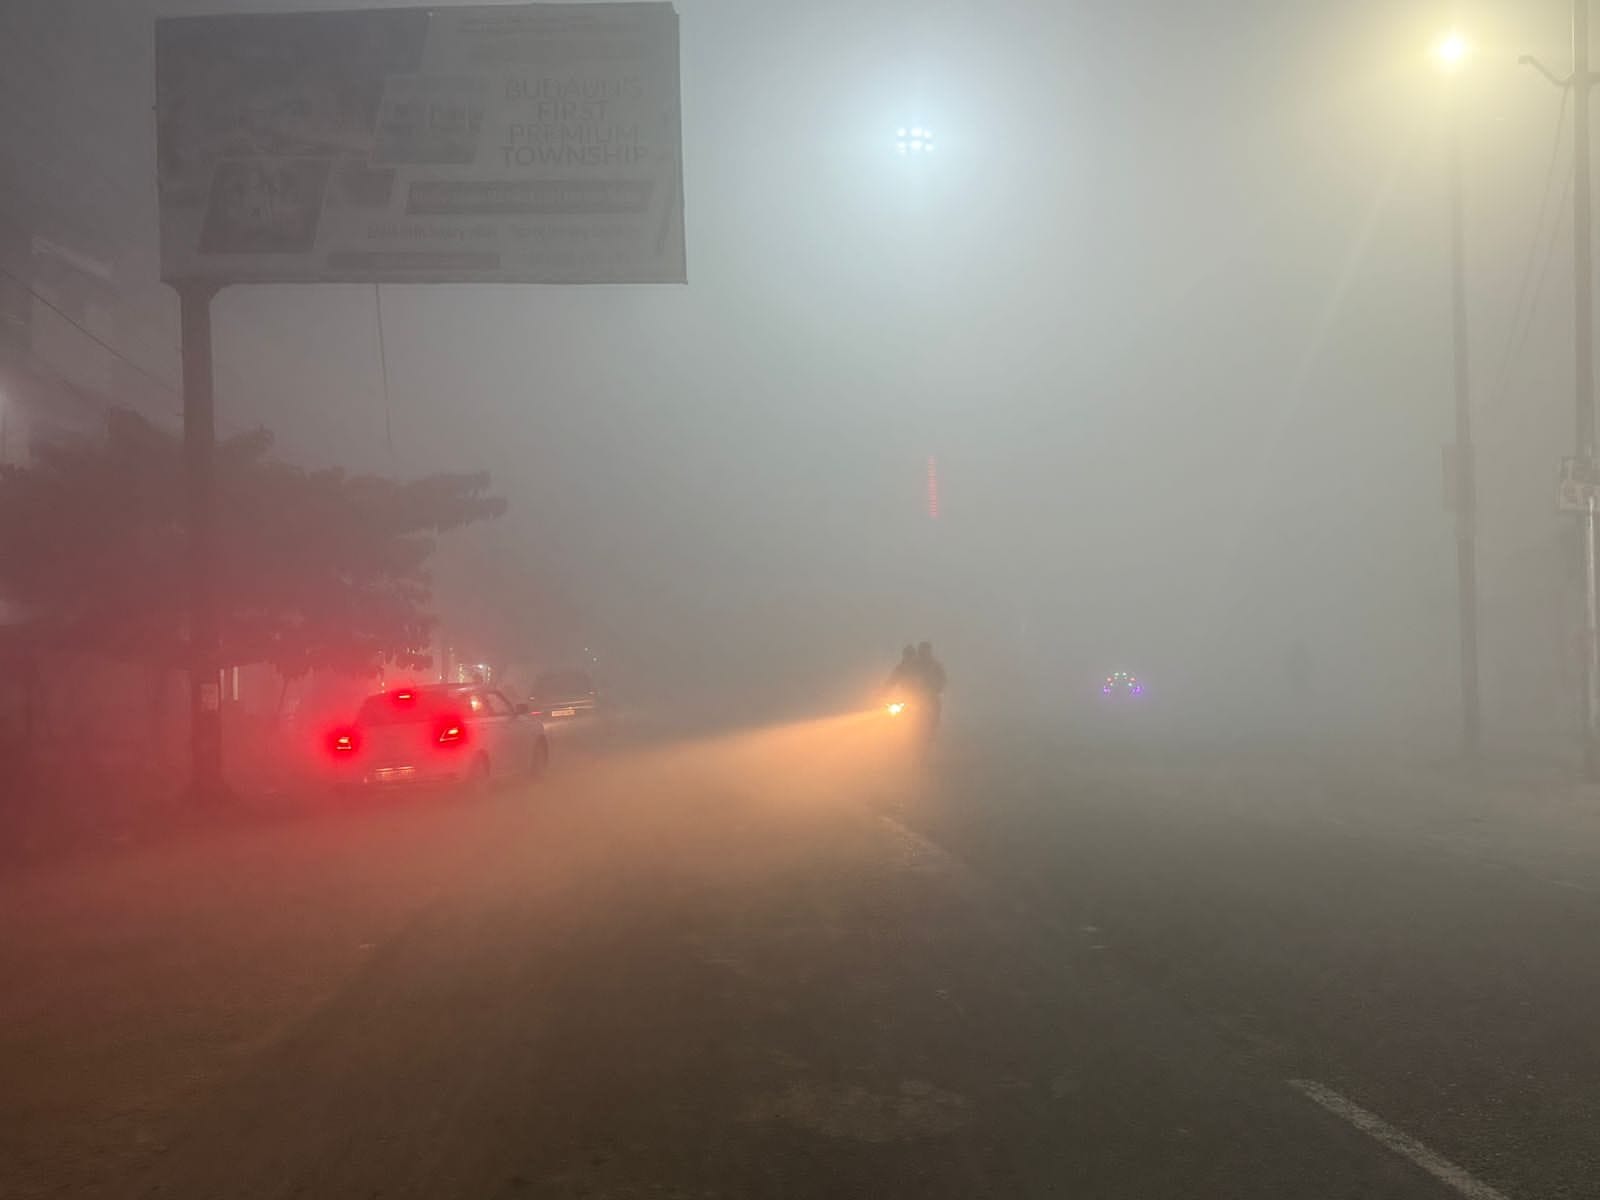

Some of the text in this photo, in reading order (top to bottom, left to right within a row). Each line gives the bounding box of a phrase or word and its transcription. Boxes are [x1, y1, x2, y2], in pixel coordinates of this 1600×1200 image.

[537, 100, 609, 121] FIRST
[509, 123, 639, 145] PREMIUM
[500, 144, 648, 167] TOWNSHIP
